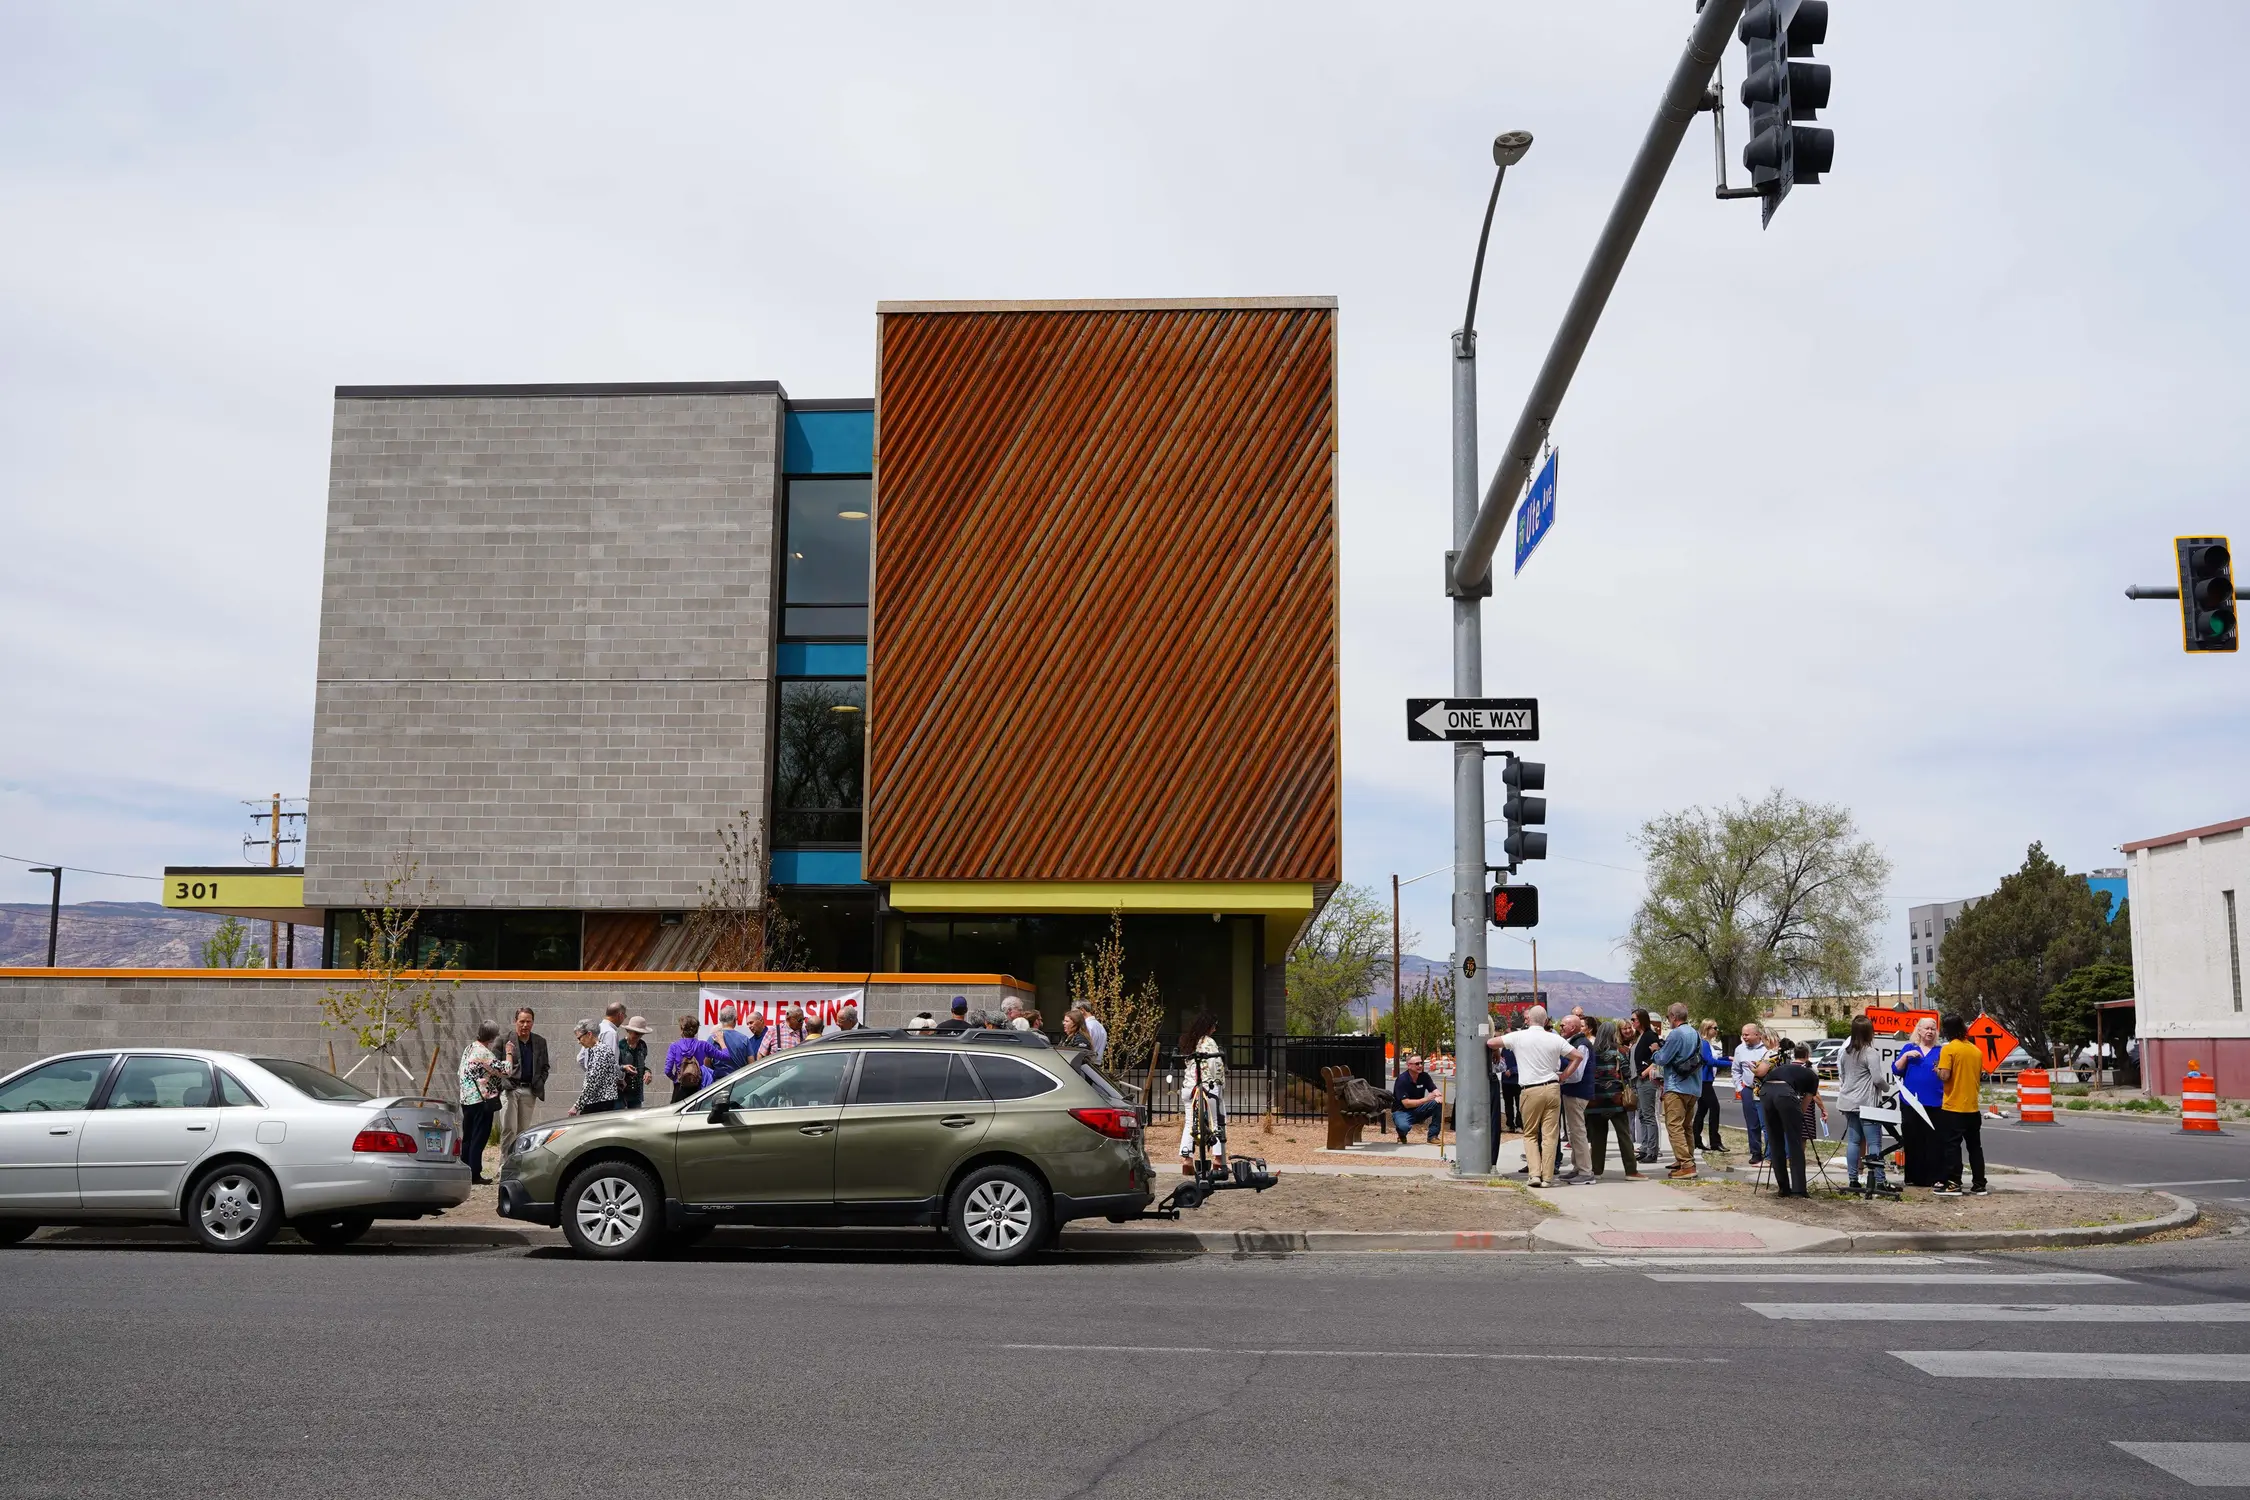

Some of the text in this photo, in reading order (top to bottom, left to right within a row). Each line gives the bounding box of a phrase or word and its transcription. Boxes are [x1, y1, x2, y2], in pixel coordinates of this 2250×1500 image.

[1526, 483, 1552, 544] Ute Ave
[1448, 711, 1526, 728] ONE WAY
[175, 882, 218, 900] 301
[1870, 1015, 1900, 1026] WORK
